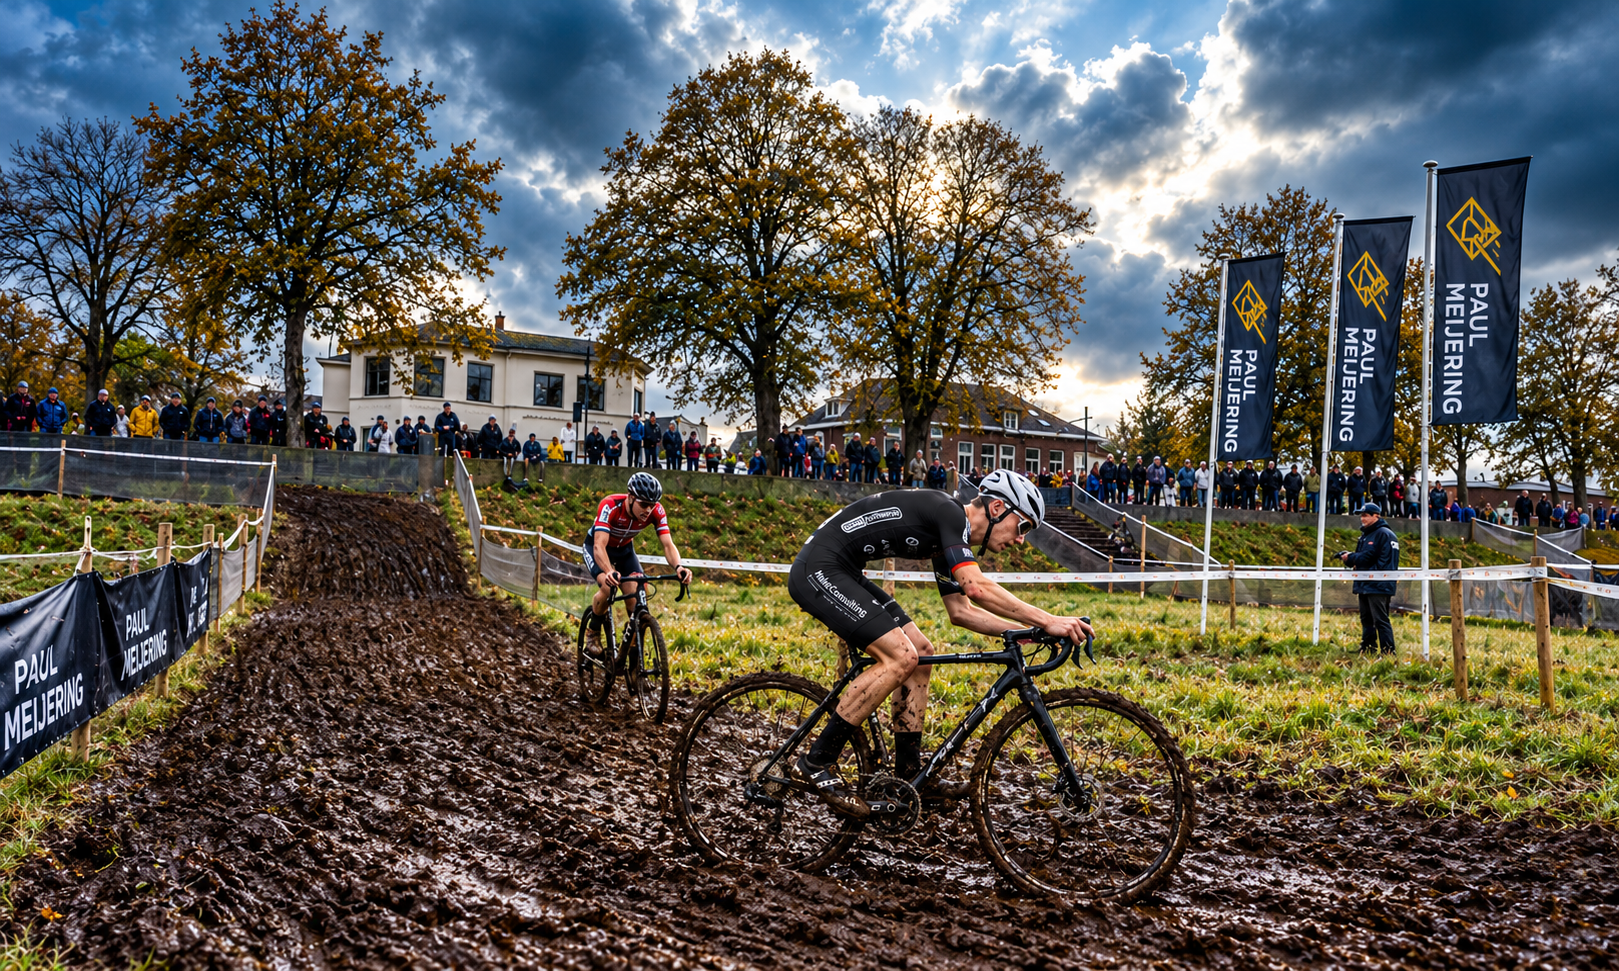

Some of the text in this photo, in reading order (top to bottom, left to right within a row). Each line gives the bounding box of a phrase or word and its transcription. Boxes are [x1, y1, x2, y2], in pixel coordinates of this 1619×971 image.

[1468, 282, 1489, 347] PAUL
[1242, 349, 1259, 401] PAUL
[1359, 328, 1377, 384] PAUL
[1442, 283, 1466, 415] MEIJERING
[1224, 349, 1244, 453] MEIJERING
[1339, 327, 1360, 442] MEIJERING
[125, 607, 150, 641] PAUL
[14, 645, 59, 695] PAUL
[120, 628, 168, 681] MEIJERING
[4, 672, 84, 751] MEIJERING
